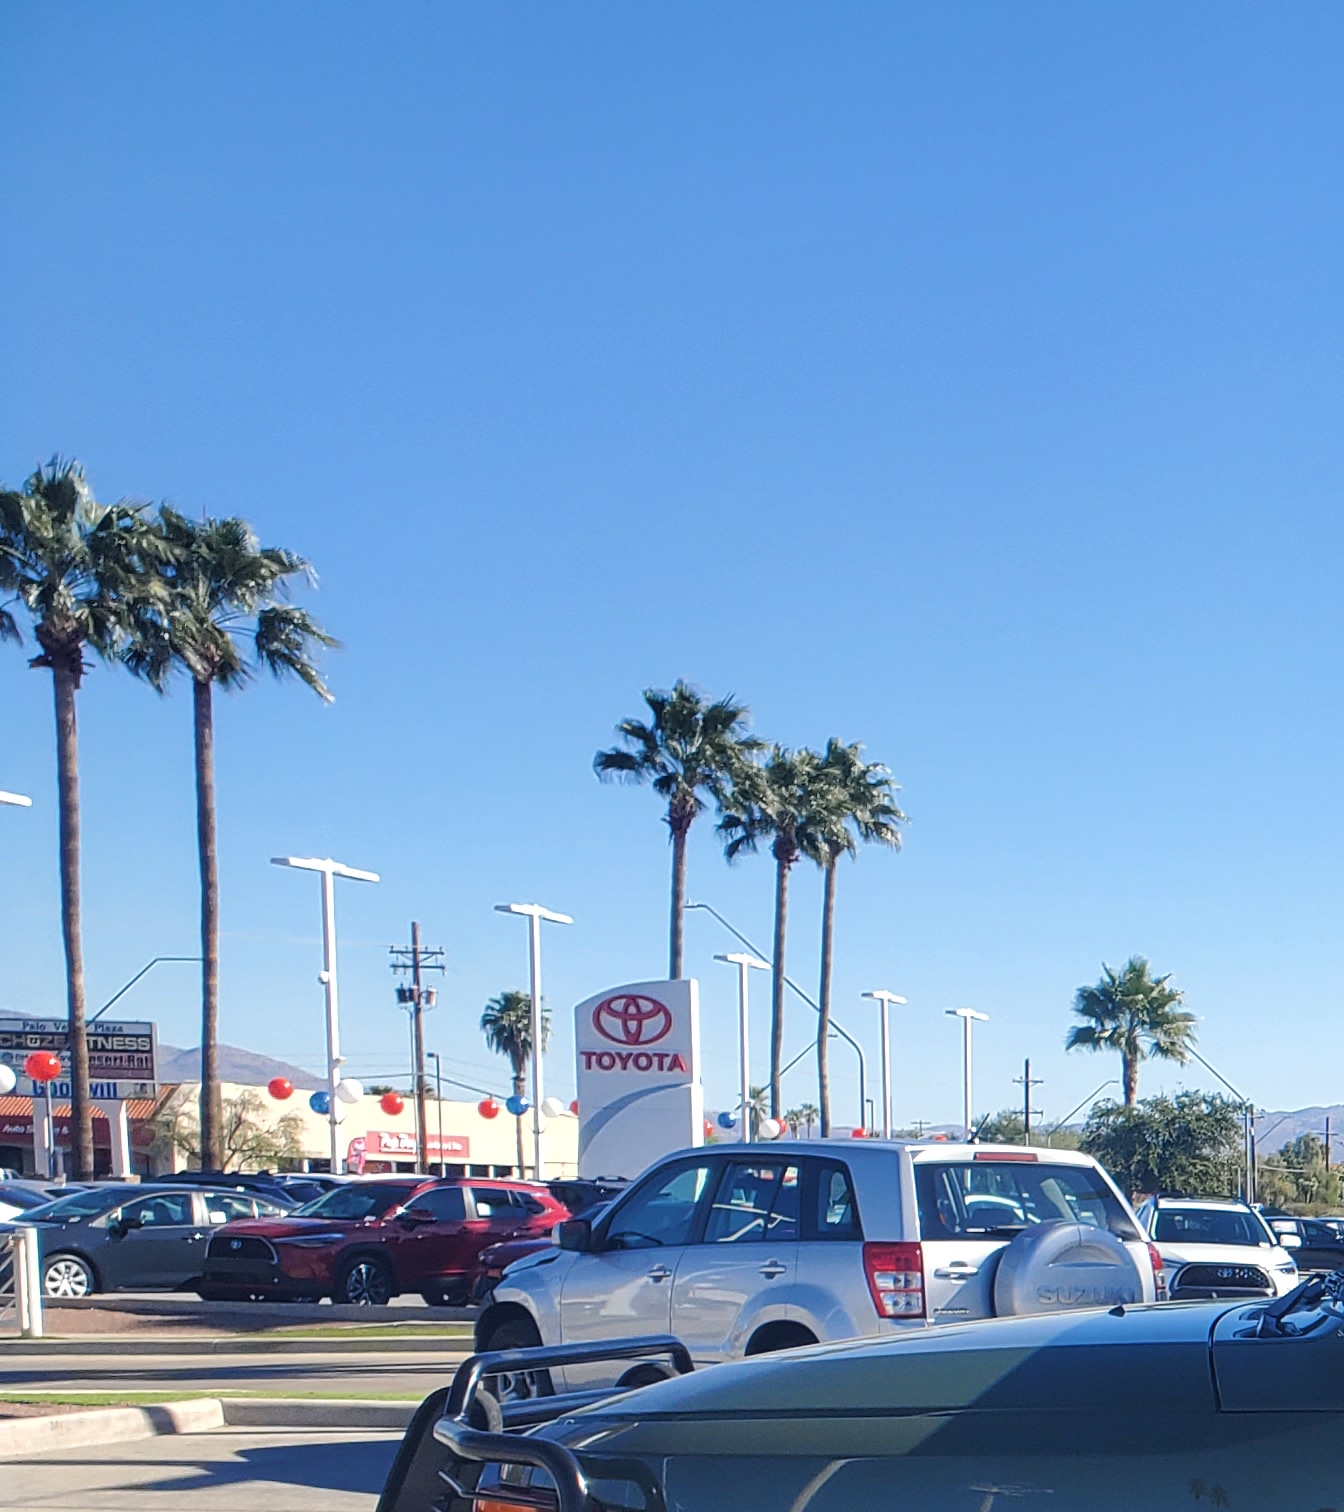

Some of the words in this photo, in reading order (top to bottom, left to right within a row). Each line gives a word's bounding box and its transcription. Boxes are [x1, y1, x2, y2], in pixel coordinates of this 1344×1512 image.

[22, 1021, 46, 1031] Palo
[94, 1023, 124, 1033] Plaza
[86, 1036, 150, 1050] TNESS
[580, 1051, 687, 1072] TOYOTA
[32, 1080, 118, 1098] Goowill
[1037, 1285, 1136, 1305] SUZUKI
